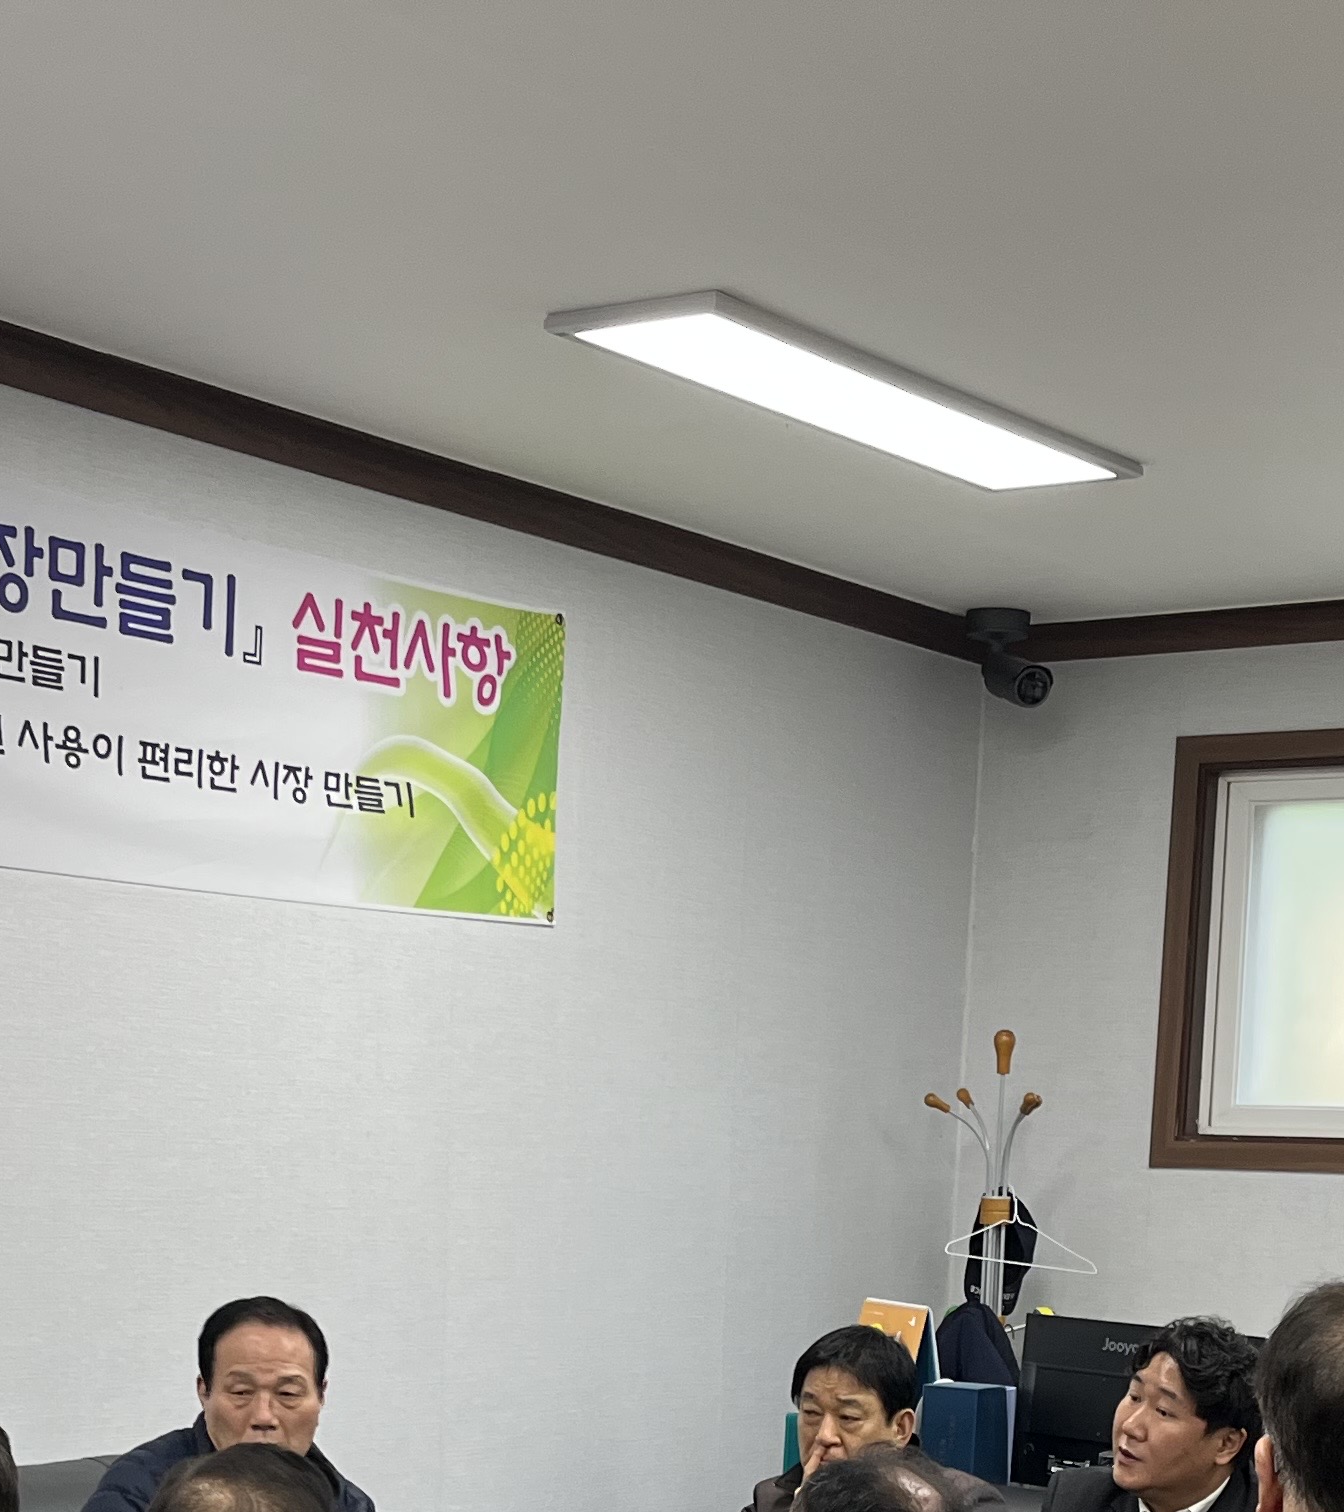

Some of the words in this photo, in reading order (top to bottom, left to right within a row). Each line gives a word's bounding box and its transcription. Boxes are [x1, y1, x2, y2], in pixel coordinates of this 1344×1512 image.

[292, 591, 513, 708] 실천사항
[18, 721, 124, 776] 사용이
[138, 739, 239, 794] 편리한
[250, 759, 313, 805] 시장
[323, 770, 416, 819] 만들기
